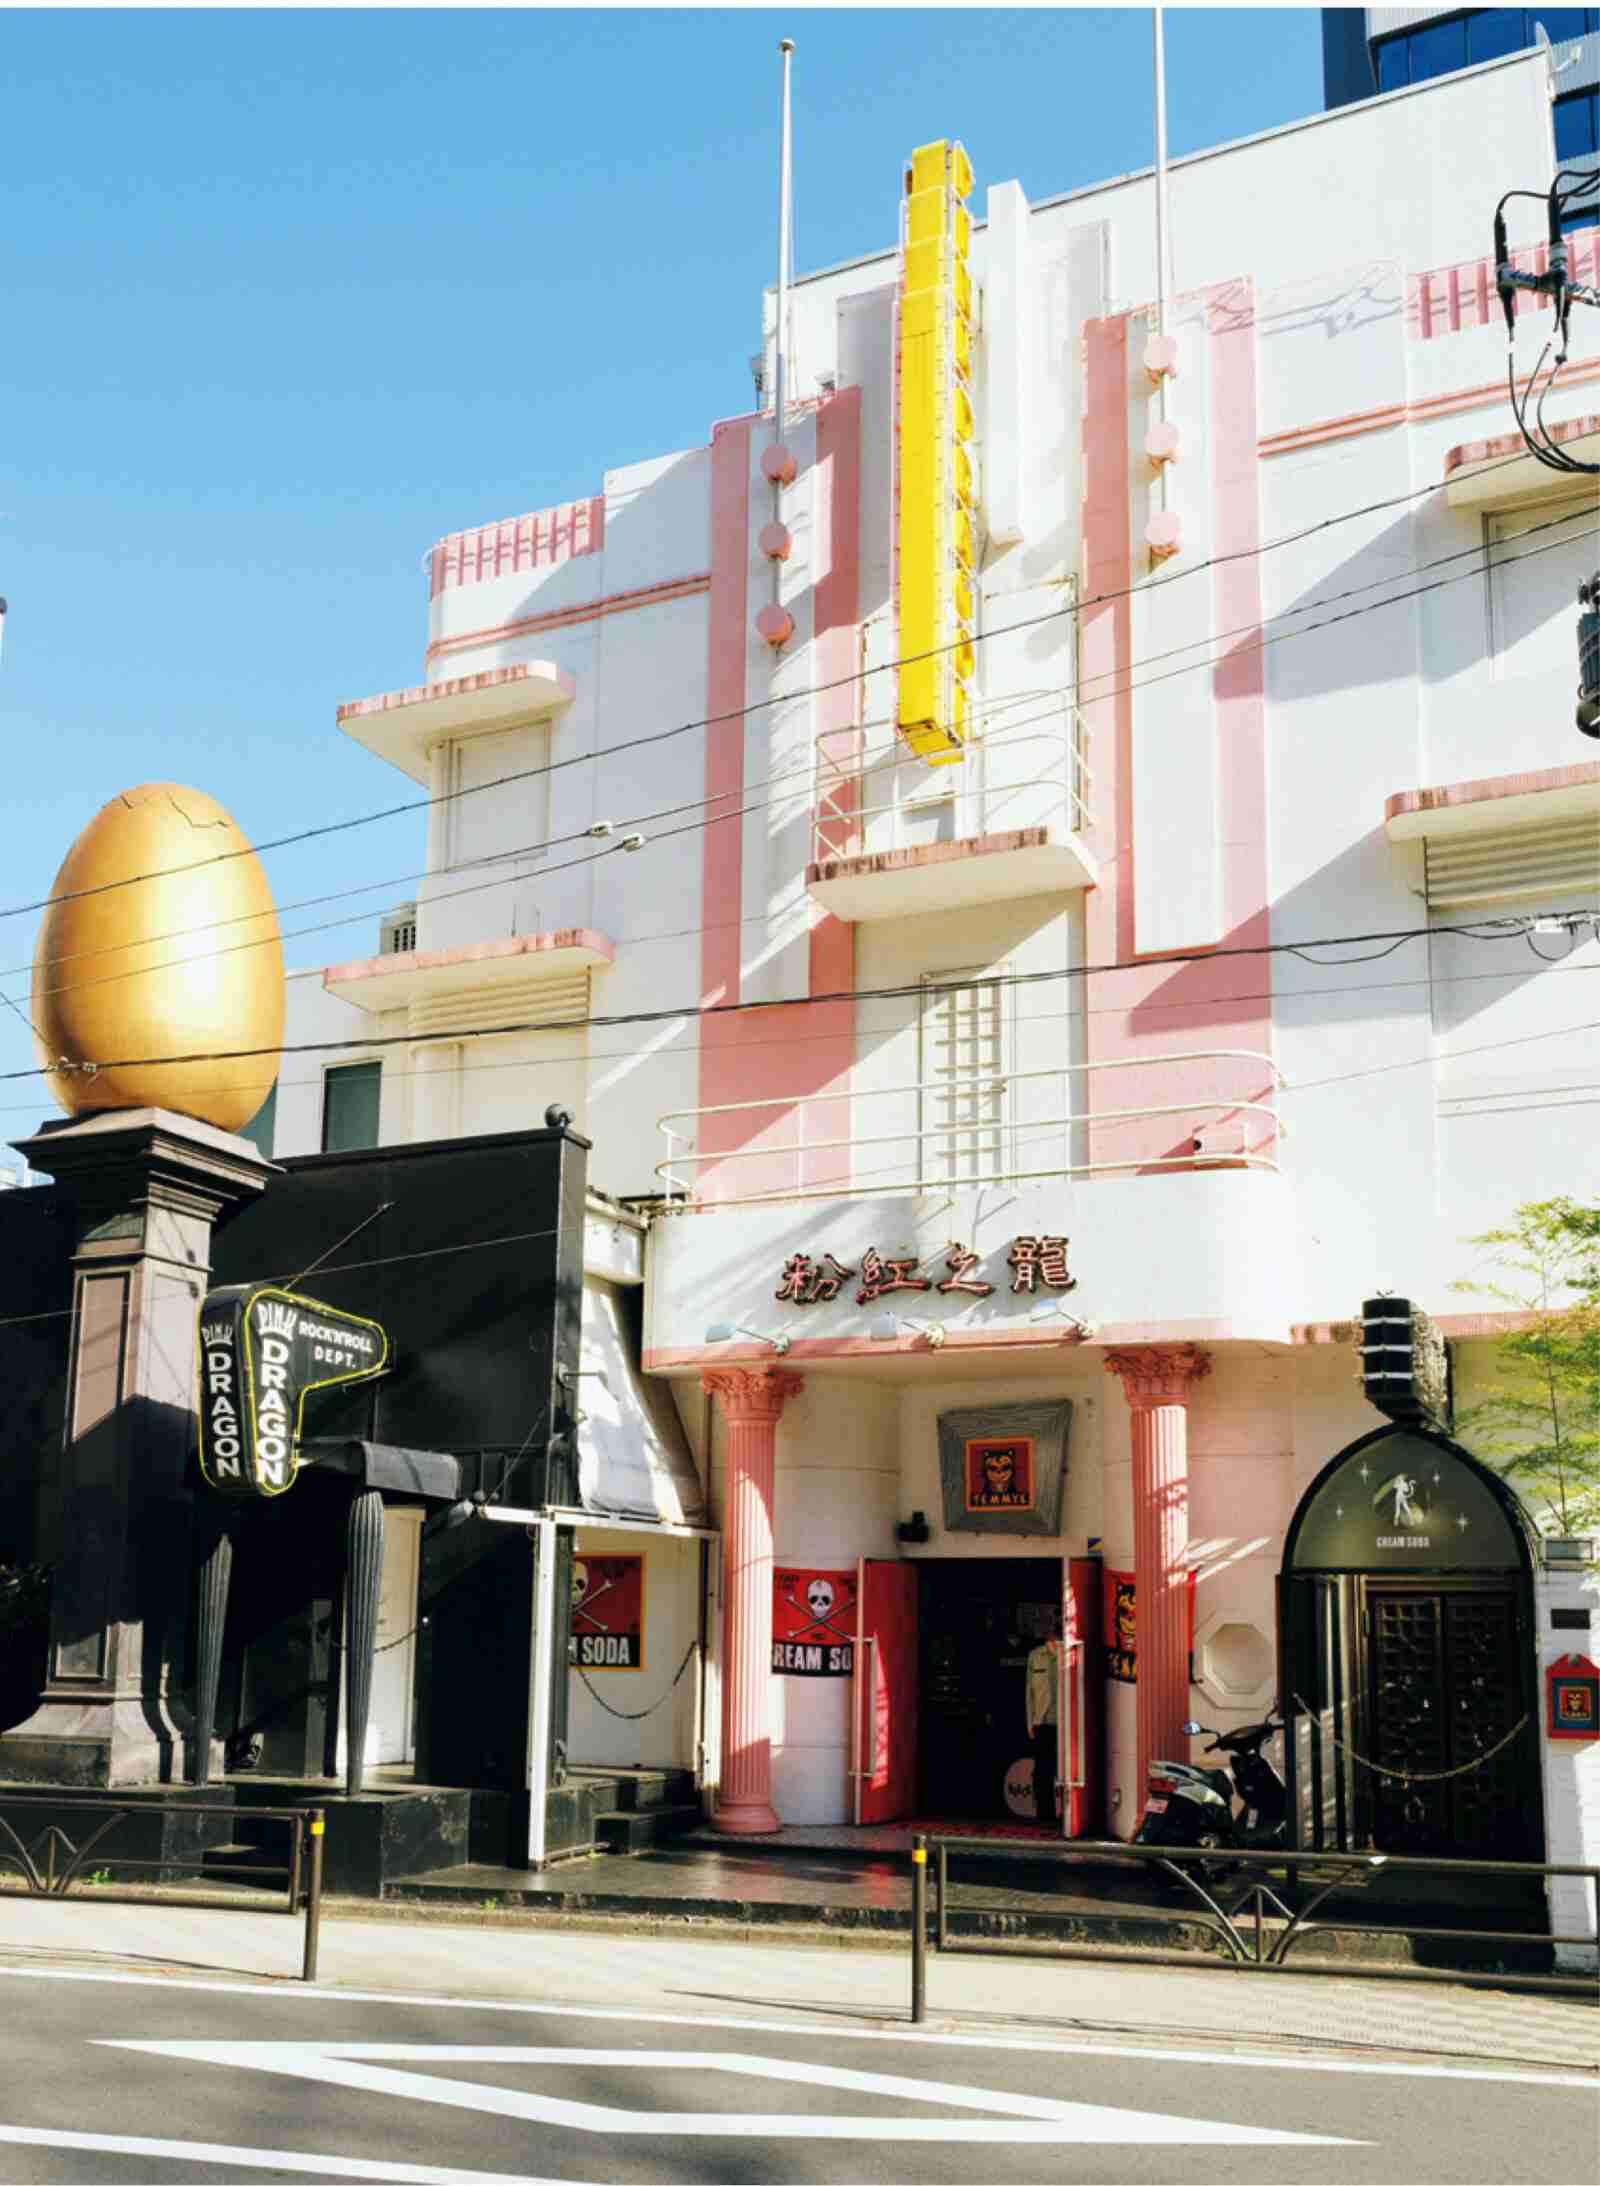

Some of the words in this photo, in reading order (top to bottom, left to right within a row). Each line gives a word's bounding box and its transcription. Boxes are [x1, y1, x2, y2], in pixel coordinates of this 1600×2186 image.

[314, 1345, 356, 1368] DEPT.
[208, 1353, 241, 1477] DRAGON
[256, 1338, 290, 1485] DRAGON
[582, 1636, 629, 1664] SODA
